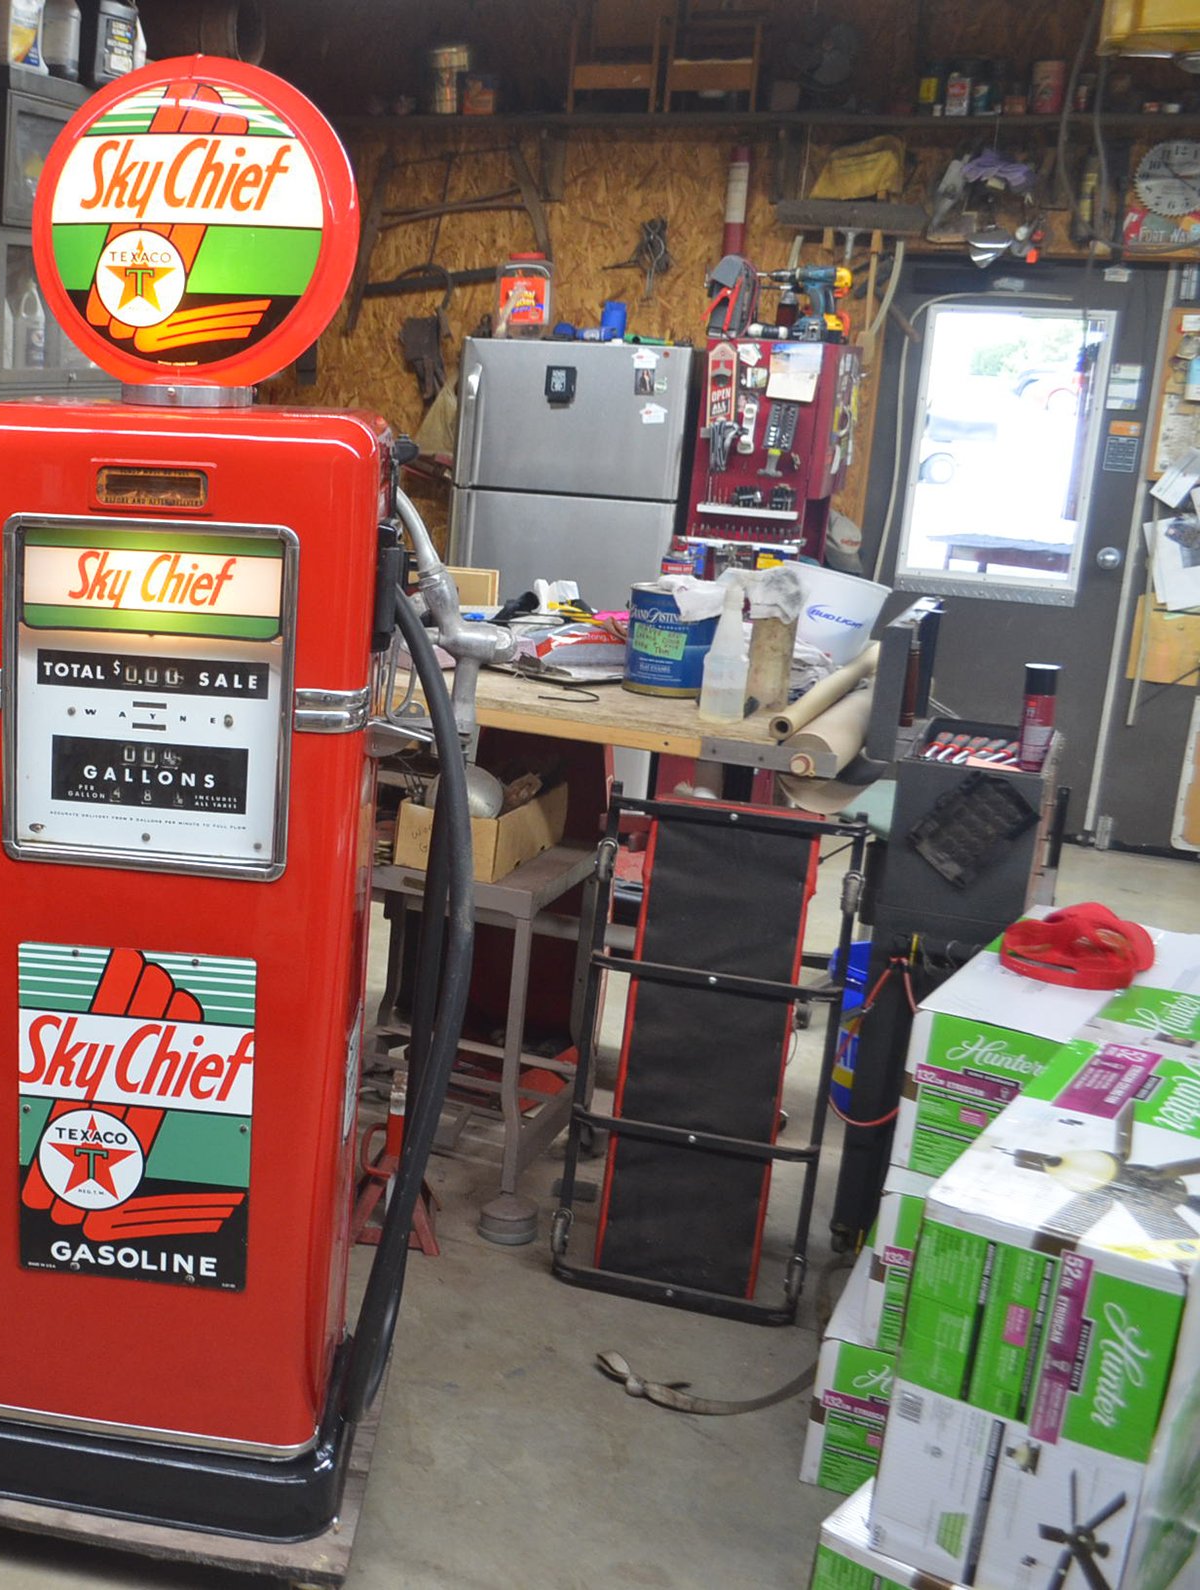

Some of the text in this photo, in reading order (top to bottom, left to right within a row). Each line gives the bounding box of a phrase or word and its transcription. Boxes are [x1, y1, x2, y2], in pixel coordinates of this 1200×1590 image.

[80, 138, 291, 218] Sky Chief
[110, 250, 171, 264] TEXACO
[125, 268, 154, 297] T
[711, 387, 731, 402] OPEN
[68, 550, 236, 608] Sky Chief
[43, 661, 105, 680] TOTAL
[199, 672, 258, 690] SALE
[83, 765, 215, 788] GALLONS
[67, 790, 105, 799] GALLON
[19, 1014, 254, 1101] Sky Chief
[946, 1035, 1048, 1077] Hunter
[55, 1127, 128, 1145] TEXACO
[74, 1147, 108, 1180] T
[50, 1241, 217, 1278] GASOLINE
[1050, 1295, 1069, 1345] ETRUSCAN
[1090, 1302, 1150, 1428] Hunter
